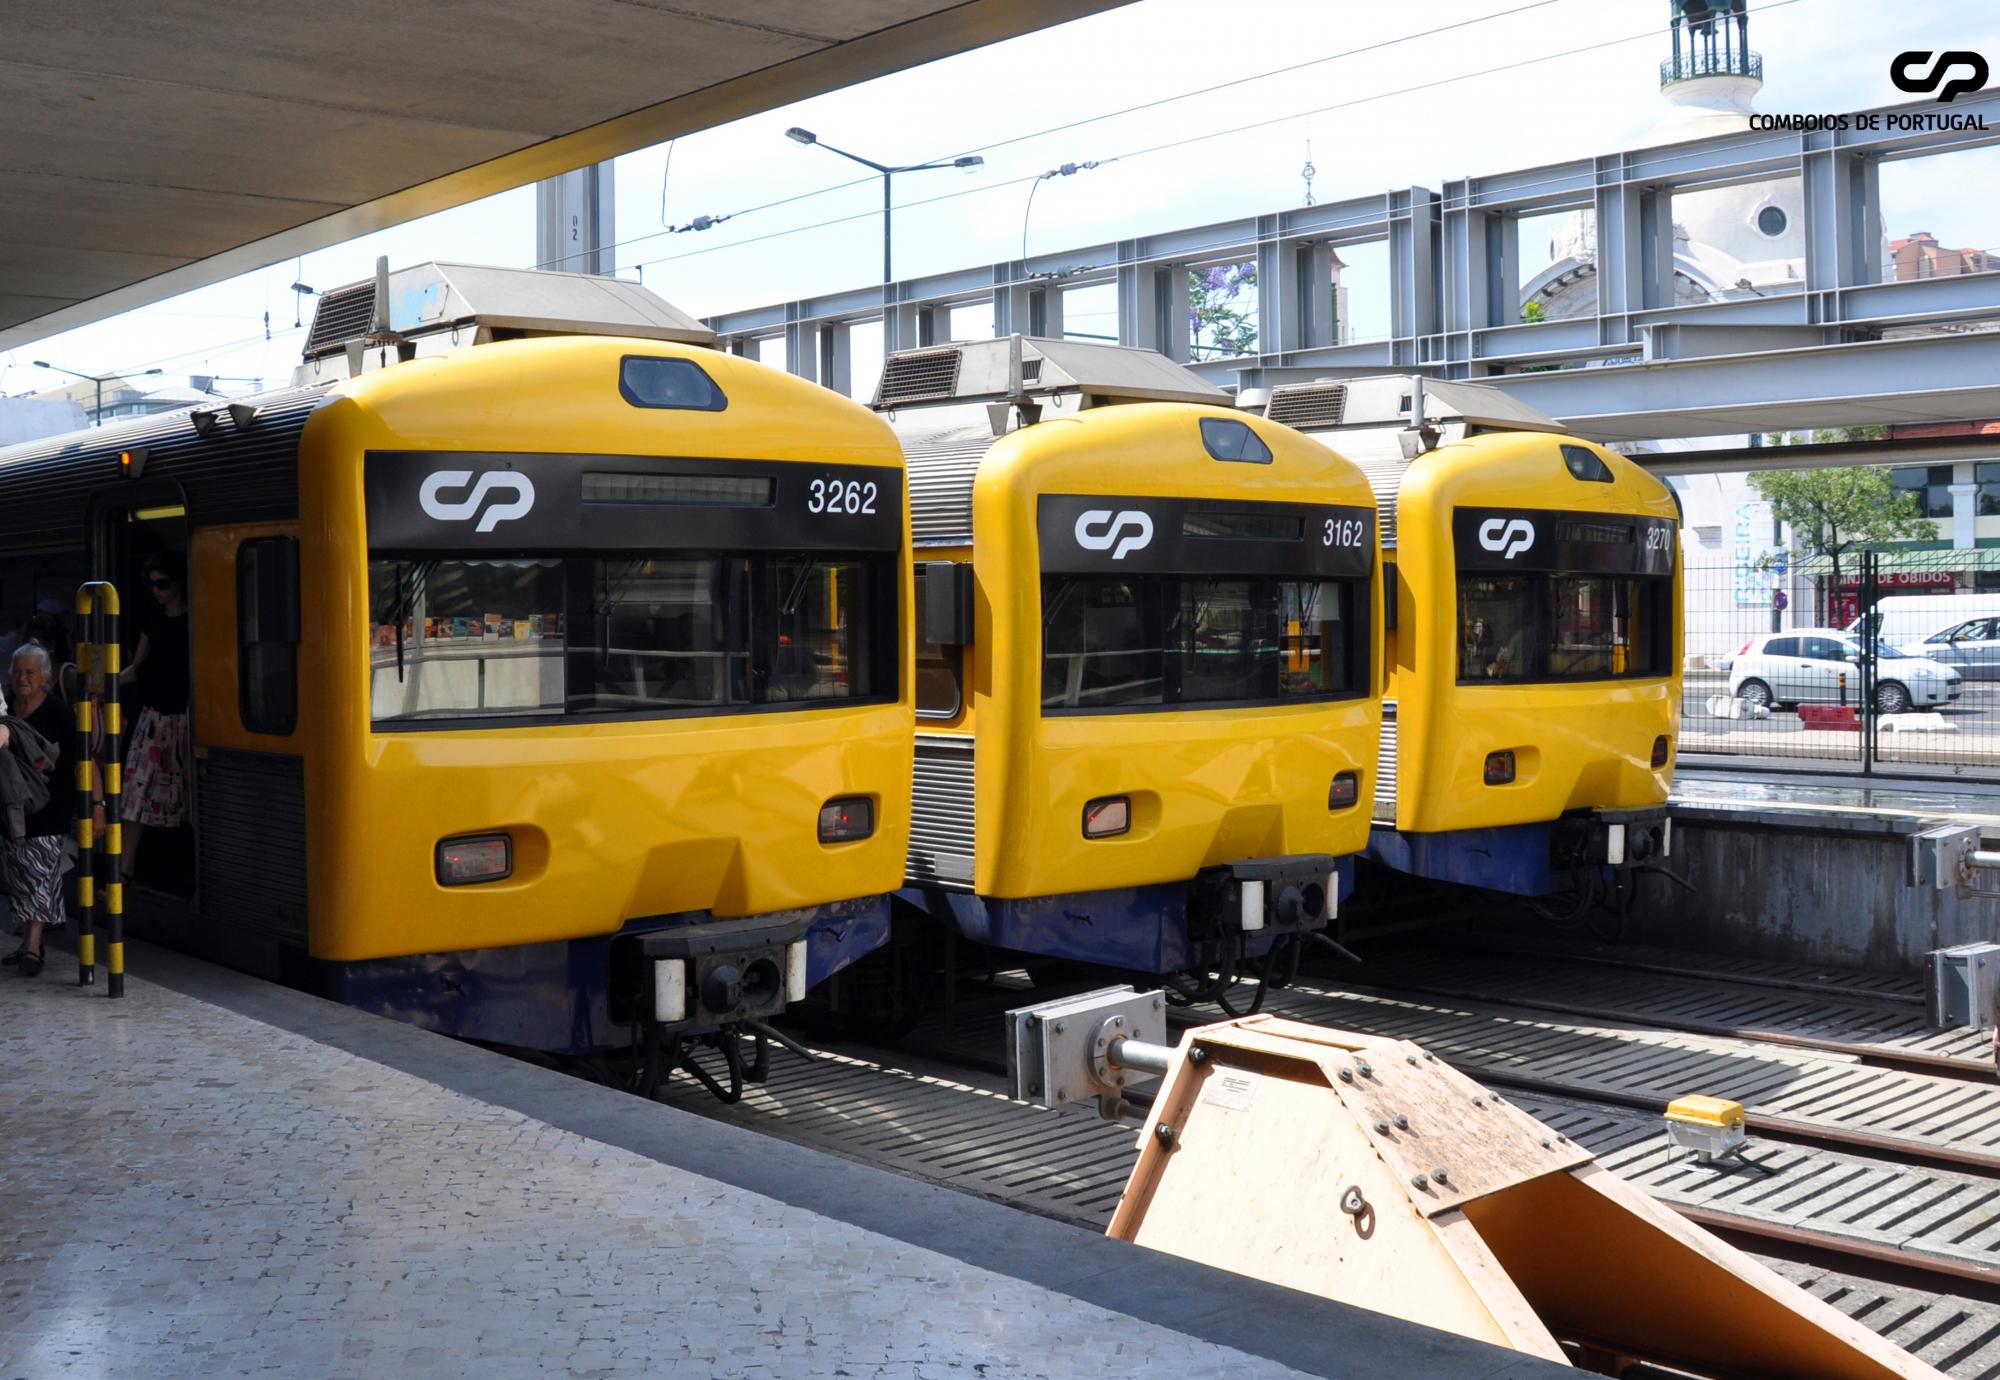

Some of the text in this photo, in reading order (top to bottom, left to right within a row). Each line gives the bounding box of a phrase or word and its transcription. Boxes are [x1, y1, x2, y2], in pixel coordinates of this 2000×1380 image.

[808, 479, 877, 515] 3262
[1323, 519, 1364, 548] 3162
[1646, 527, 1671, 551] 3270
[1877, 571, 1894, 584] DE
